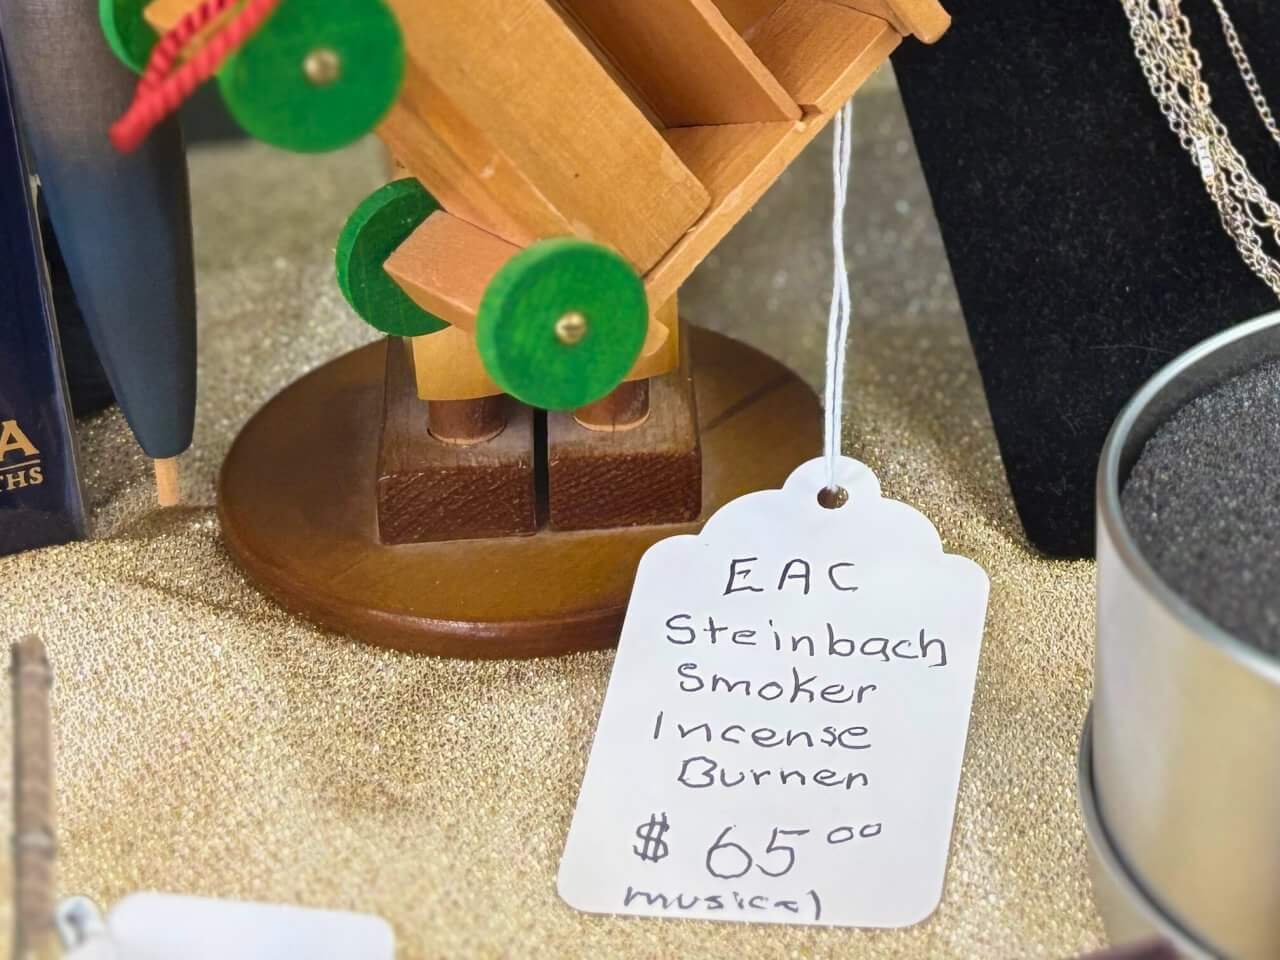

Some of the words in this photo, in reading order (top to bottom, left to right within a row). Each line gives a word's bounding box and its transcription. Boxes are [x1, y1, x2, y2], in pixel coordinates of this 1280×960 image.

[723, 557, 859, 596] EAC
[666, 614, 947, 667] Steinbach
[677, 662, 877, 704] Smoker
[653, 711, 872, 749] Incense
[677, 756, 868, 789] Burner
[624, 885, 822, 921] musical
